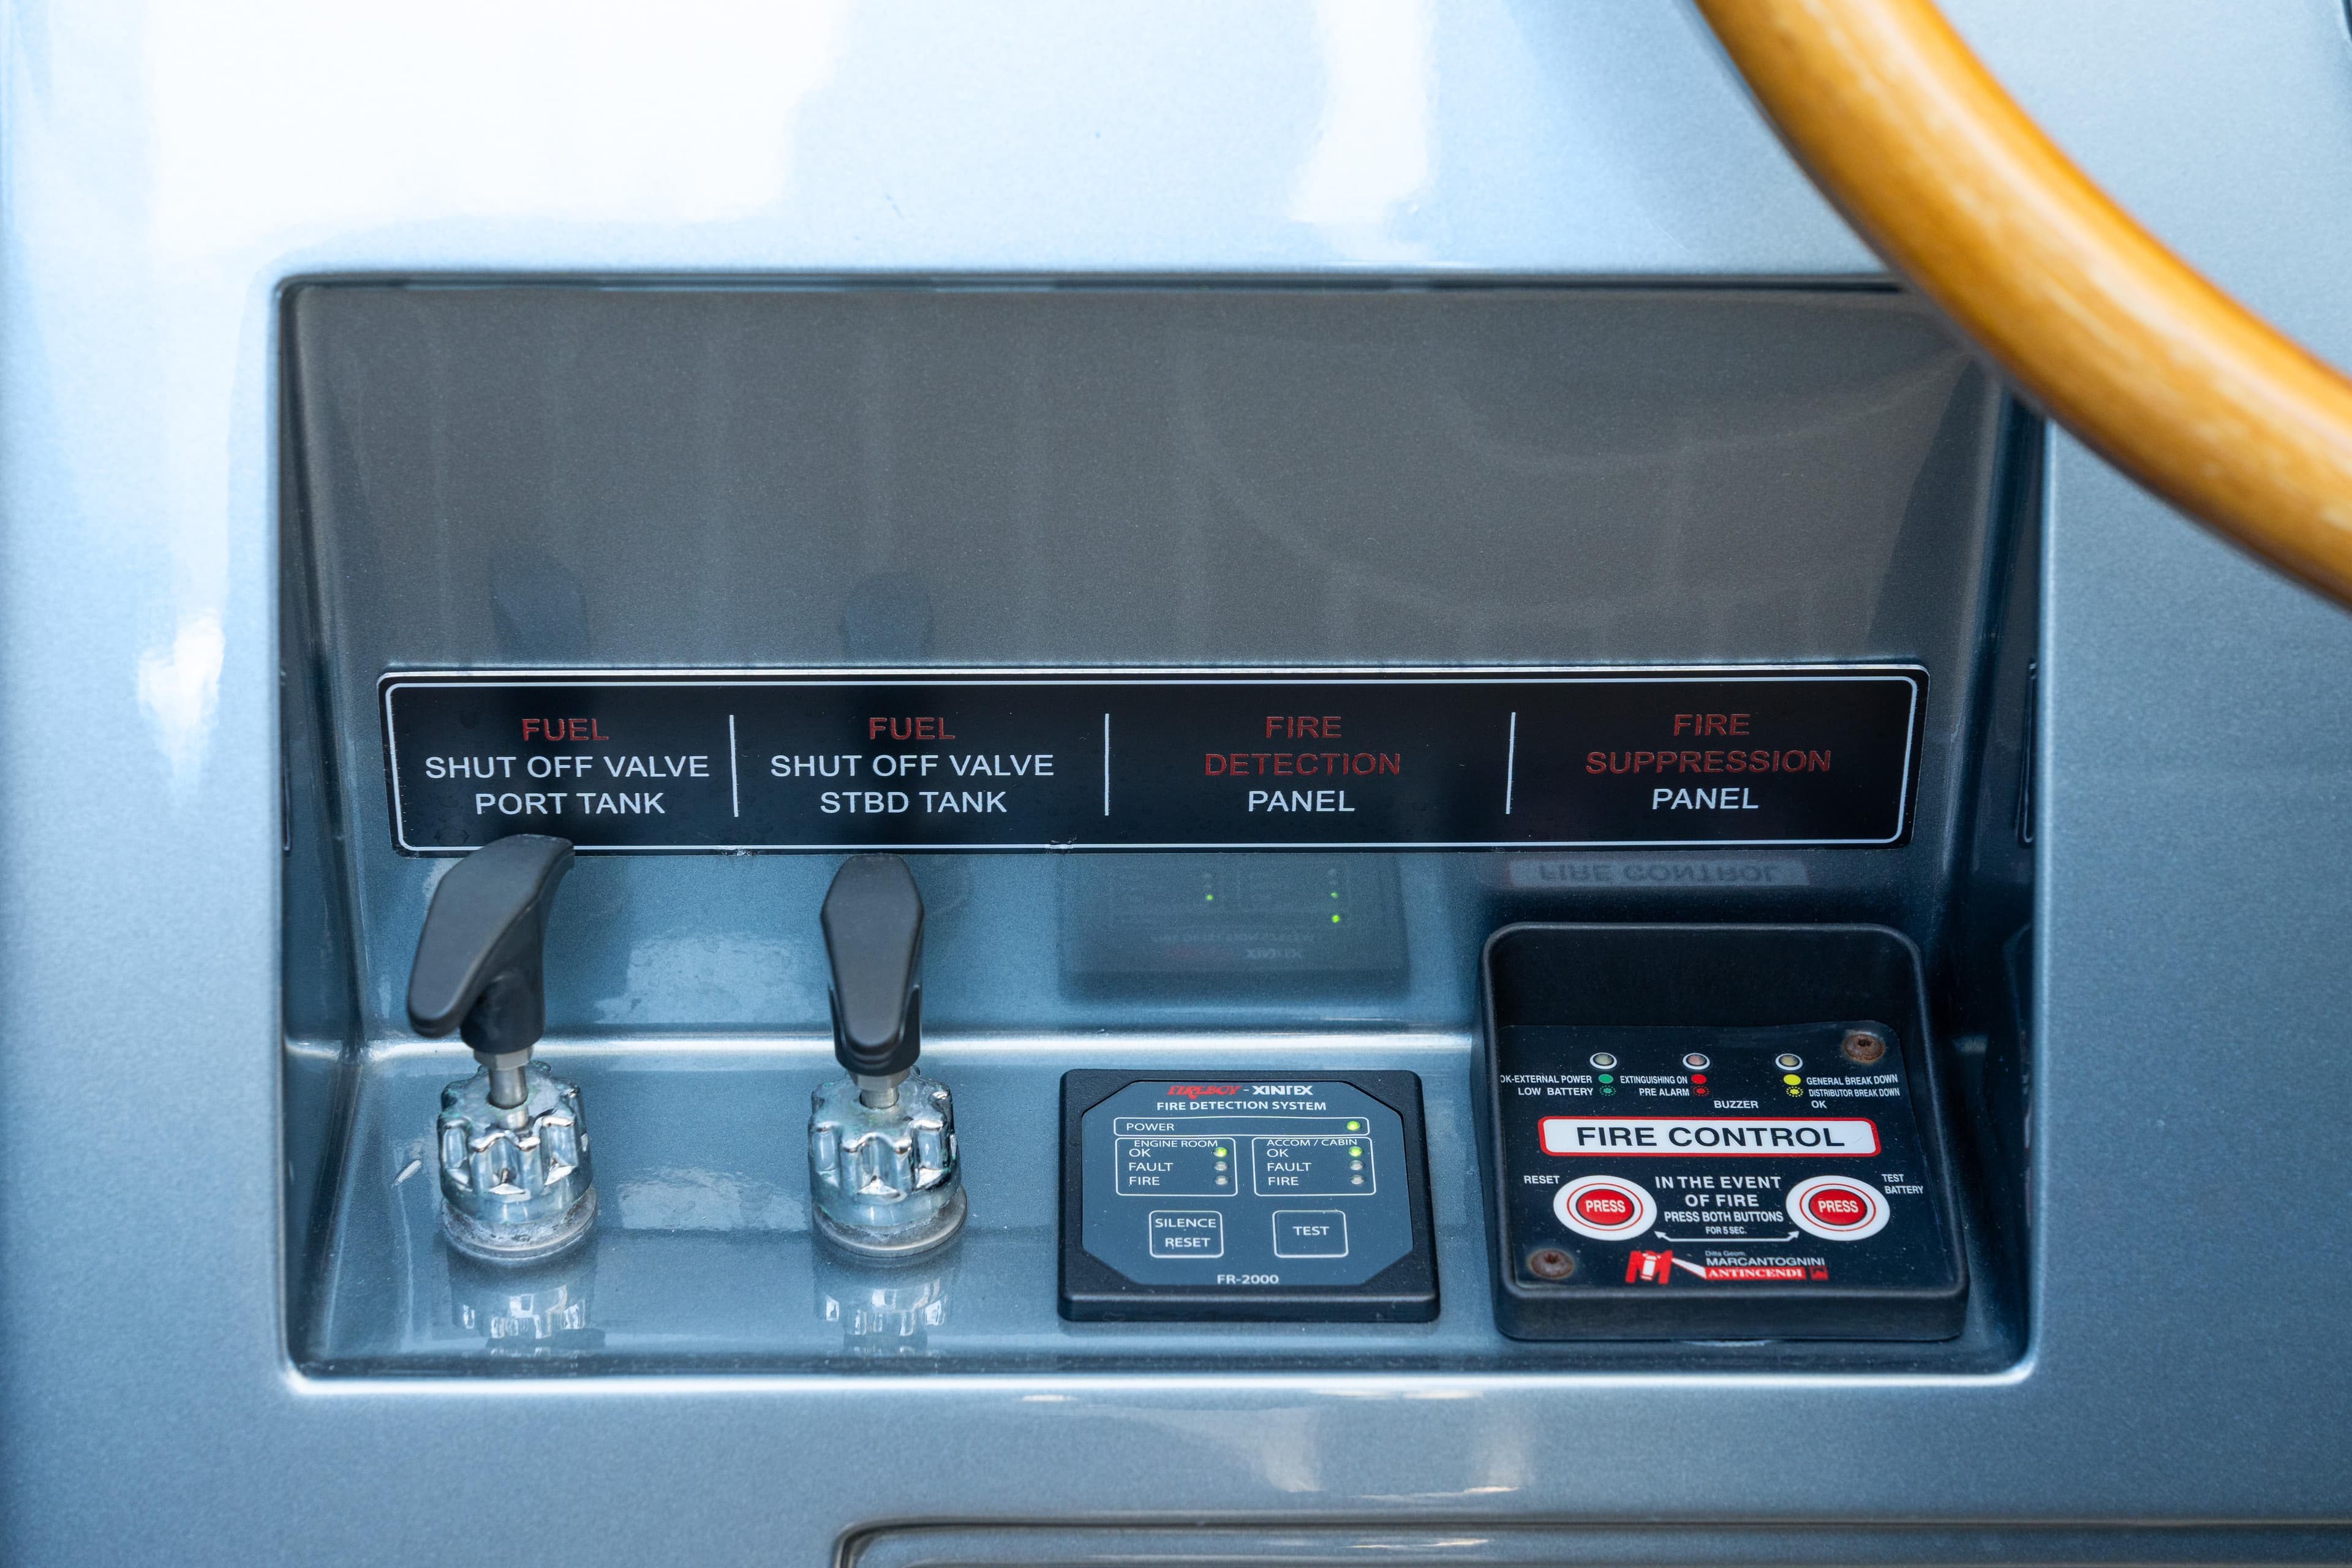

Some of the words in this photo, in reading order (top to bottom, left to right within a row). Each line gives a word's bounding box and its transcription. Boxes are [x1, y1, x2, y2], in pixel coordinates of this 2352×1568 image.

[522, 718, 609, 741] FUEL
[869, 717, 956, 740] FUEL
[1265, 716, 1341, 739] FIRE
[1673, 714, 1750, 736] FIRE
[426, 756, 516, 778] SHUT
[527, 756, 593, 778] OFF
[603, 755, 709, 777] VALVE
[771, 755, 862, 777] SHUT
[873, 755, 938, 777] OFF
[949, 754, 1054, 776] VALVE
[1205, 753, 1400, 776] DETECTION
[1586, 750, 1831, 774] SUPPRESSION
[476, 793, 567, 815] PORT
[576, 793, 665, 814] TANK
[820, 792, 909, 813] STBD
[919, 791, 1006, 813] TANK
[1248, 791, 1355, 812] PANEL
[1652, 788, 1758, 809] PANEL
[1806, 1077, 1844, 1085] GENERAL
[1845, 1076, 1872, 1085] BREAK
[1874, 1074, 1898, 1084] DOWN
[1659, 1088, 1689, 1096] ALARM
[1809, 1088, 1853, 1097] DISTRIBUTOR
[1854, 1088, 1878, 1097] BREAK
[1879, 1087, 1900, 1096] DOWN
[1156, 1102, 1186, 1110] FIRE
[1190, 1101, 1269, 1110] DETECTION
[1272, 1101, 1326, 1110] SYSTEM
[1126, 1123, 1174, 1131] POWER
[1577, 1127, 1657, 1146] FIRE
[1668, 1127, 1845, 1147] CONTROL
[1129, 1148, 1151, 1158] OK
[1267, 1148, 1289, 1158] OK
[1129, 1163, 1173, 1171] FAULT
[1267, 1163, 1311, 1171] FAULT
[1129, 1177, 1159, 1185] FIRE
[1268, 1177, 1298, 1186] FIRE
[1524, 1175, 1560, 1184] RESET
[1655, 1176, 1673, 1189] IN
[1678, 1176, 1715, 1188] THE
[1720, 1176, 1781, 1189] EVENT
[1882, 1174, 1904, 1182] TEST
[1885, 1185, 1924, 1194] BATTERY
[1586, 1199, 1626, 1213] PRESS
[1685, 1194, 1709, 1207] OF
[1716, 1194, 1759, 1207] FIRE
[1818, 1200, 1859, 1213] PRESS
[1664, 1212, 1700, 1222] PRESS
[1702, 1212, 1732, 1222] BOTH
[1734, 1211, 1784, 1222] BUTTONS
[1155, 1218, 1216, 1228] SILENCE
[1293, 1226, 1330, 1236] TEST
[1705, 1226, 1722, 1235] FOR
[1723, 1226, 1728, 1235] 5
[1729, 1226, 1747, 1235] SEC.
[1165, 1237, 1210, 1248] RESET
[1706, 1257, 1825, 1266] MARCANTOGNINI
[1708, 1268, 1802, 1278] ANTINCENDI
[1217, 1275, 1279, 1284] FR-2000
